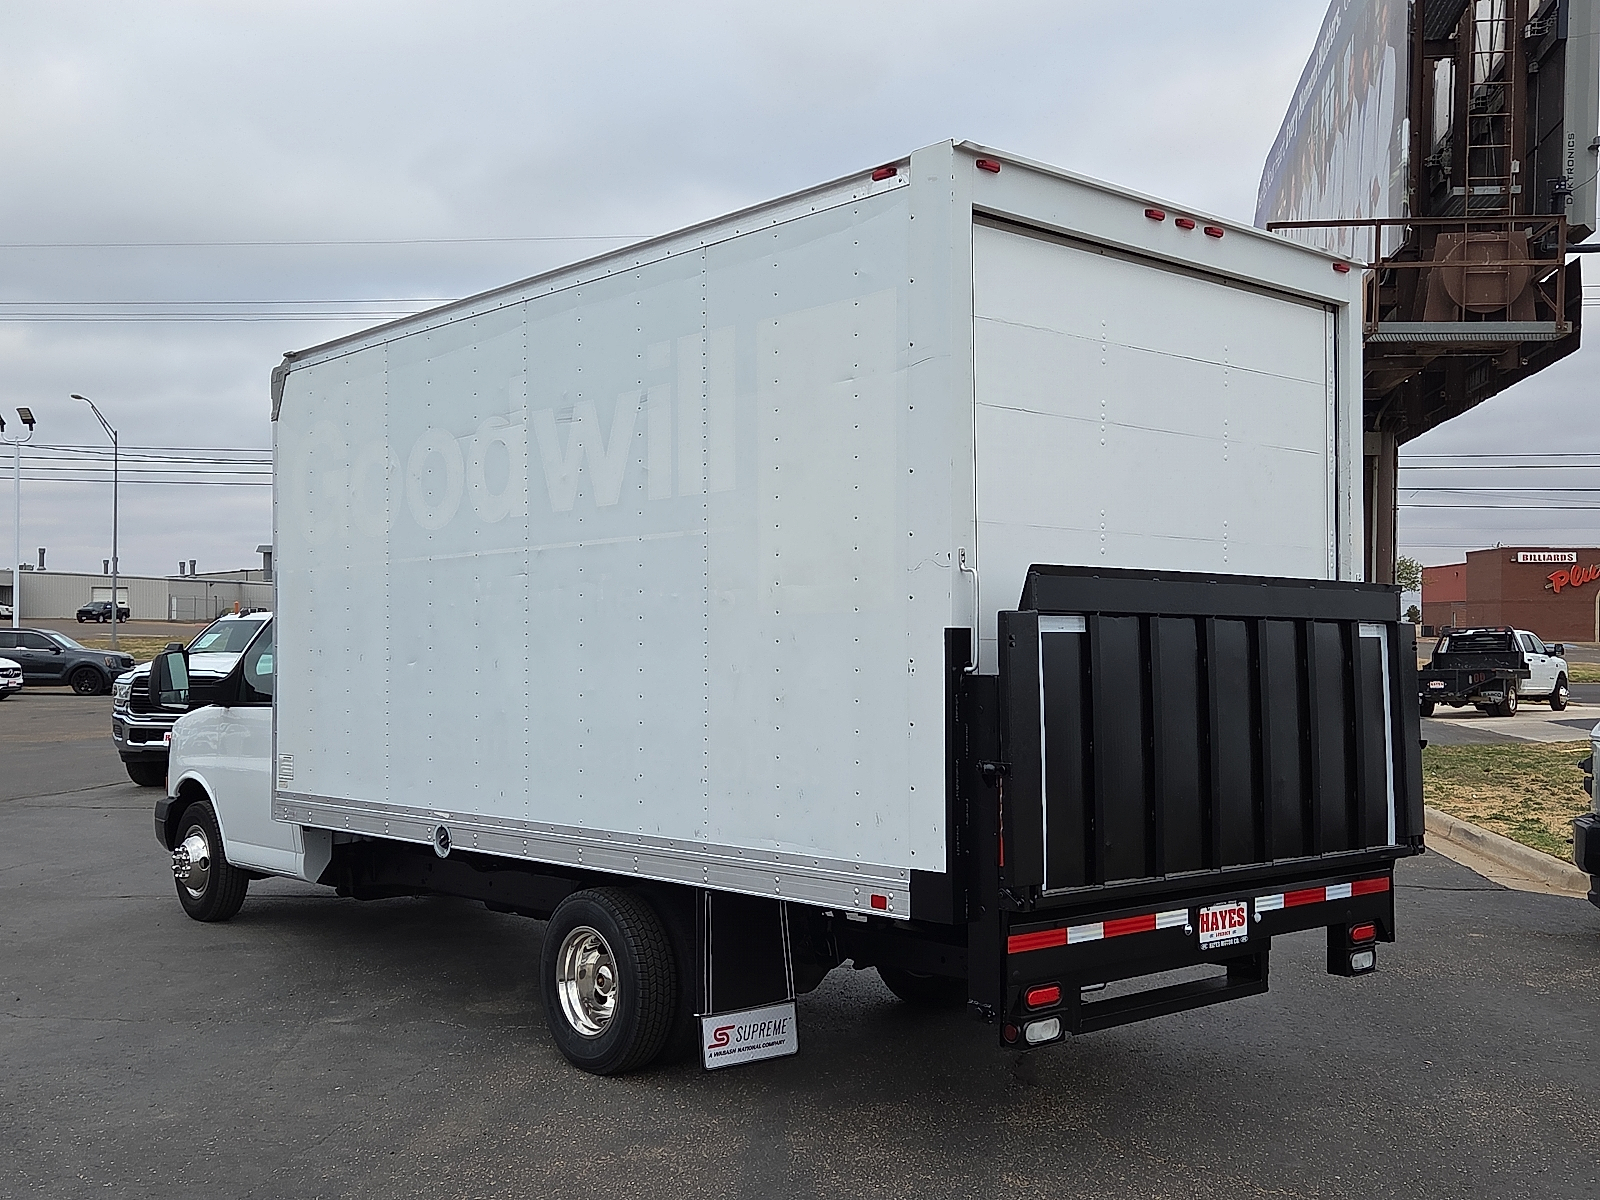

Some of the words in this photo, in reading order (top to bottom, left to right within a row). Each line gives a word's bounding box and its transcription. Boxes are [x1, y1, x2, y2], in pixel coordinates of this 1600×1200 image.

[293, 325, 736, 546] Goodwill
[1522, 553, 1574, 562] BILLIARDS
[1546, 564, 1600, 593] Plu
[1199, 907, 1246, 933] HAYES
[735, 1018, 788, 1042] SUPREME
[713, 1047, 737, 1058] WABASH
[737, 1043, 761, 1053] NATIONAL
[761, 1038, 786, 1049] COMPANY
